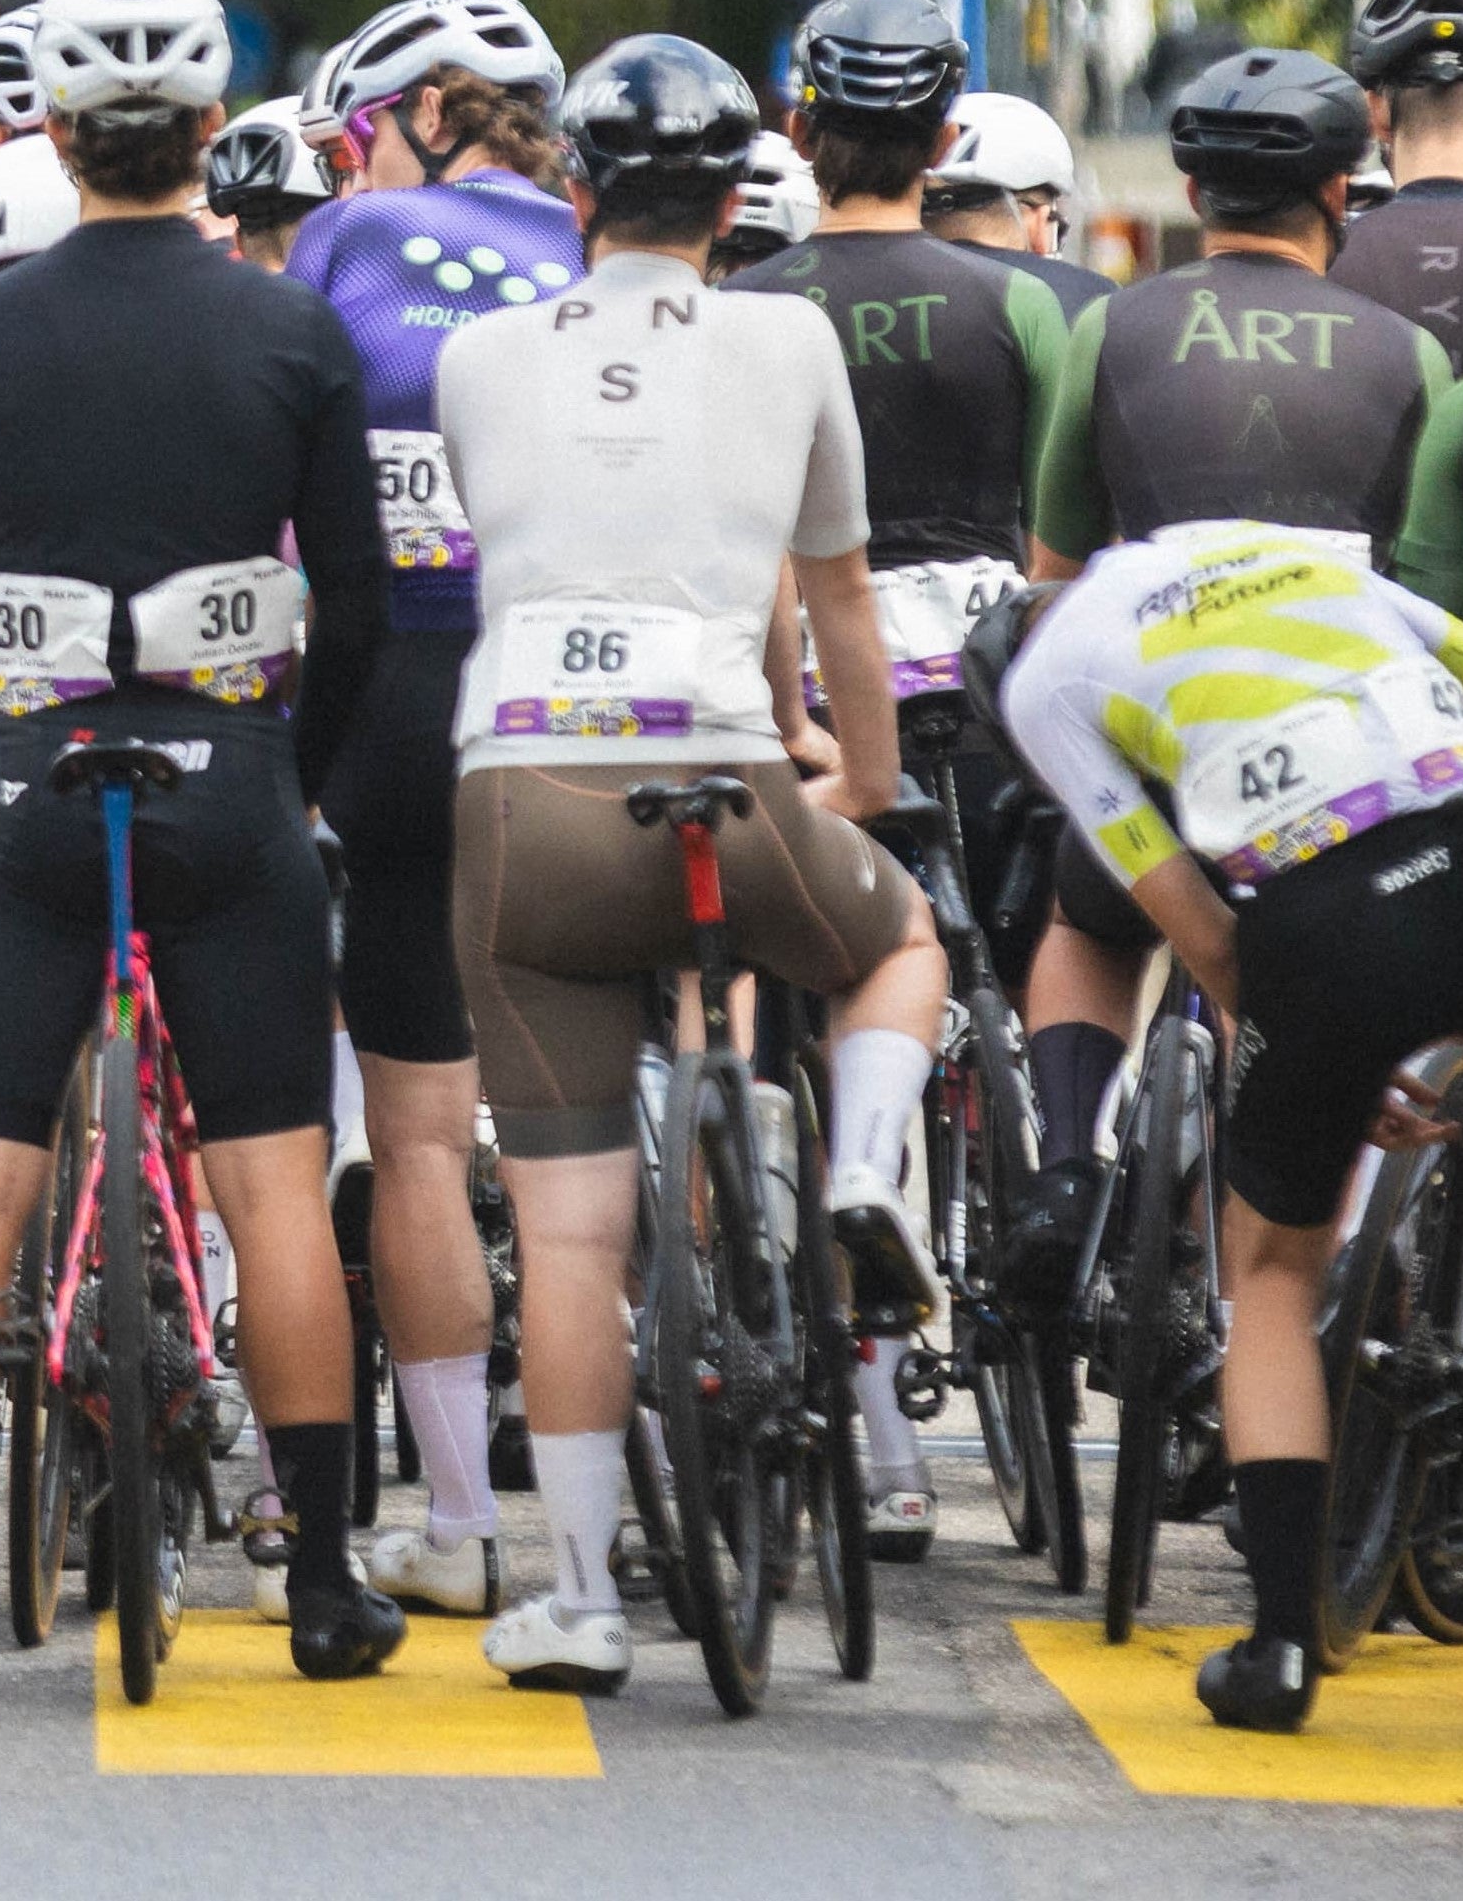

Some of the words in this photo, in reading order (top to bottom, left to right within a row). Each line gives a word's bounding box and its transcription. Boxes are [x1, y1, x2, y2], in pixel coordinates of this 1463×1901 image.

[1175, 289, 1355, 370] ÅRT
[200, 588, 256, 641] 30
[562, 626, 631, 674] 86
[1240, 743, 1307, 804] 42
[1376, 845, 1453, 896] society
